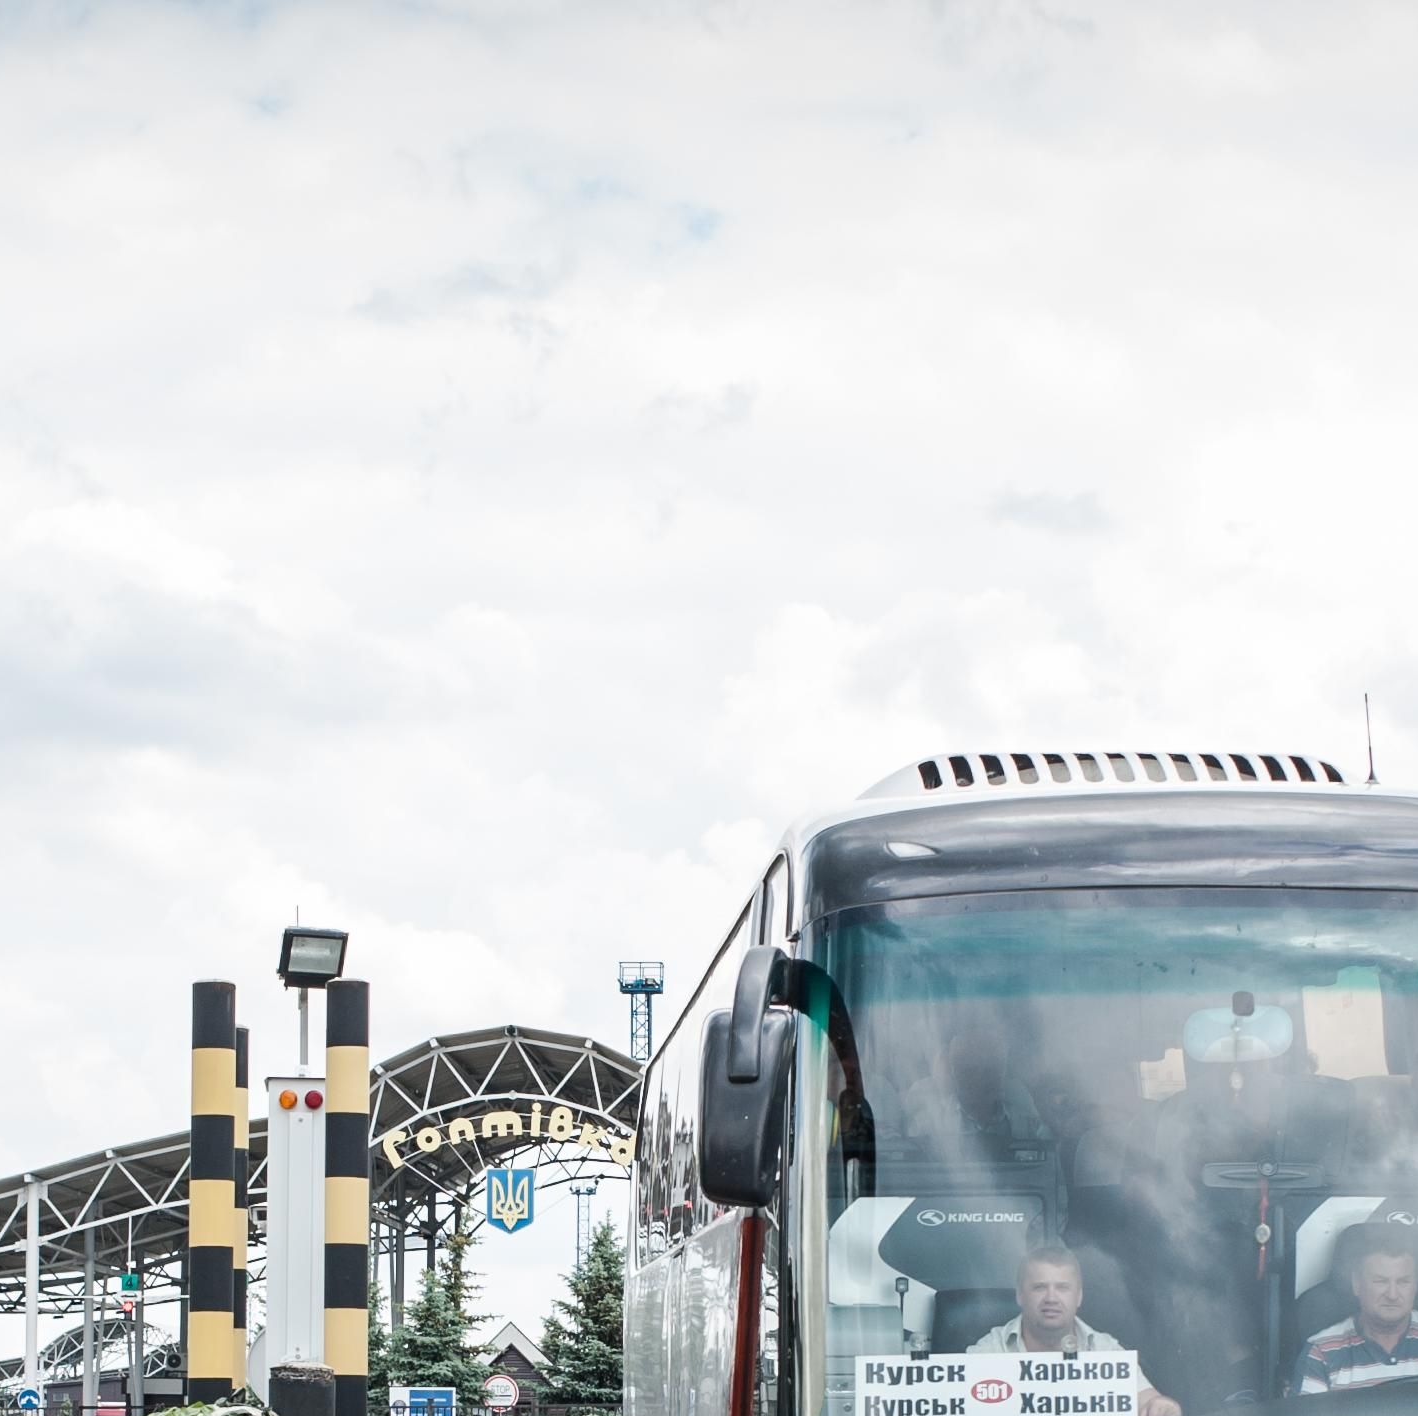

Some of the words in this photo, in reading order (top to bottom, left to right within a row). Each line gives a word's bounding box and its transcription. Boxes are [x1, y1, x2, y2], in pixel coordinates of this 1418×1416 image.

[948, 1213, 982, 1222] KING
[985, 1213, 1024, 1222] LONG
[865, 1362, 966, 1386] Курск
[1019, 1360, 1131, 1383] Харьков
[976, 1384, 1009, 1400] 501
[1020, 1391, 1131, 1416] Харьків
